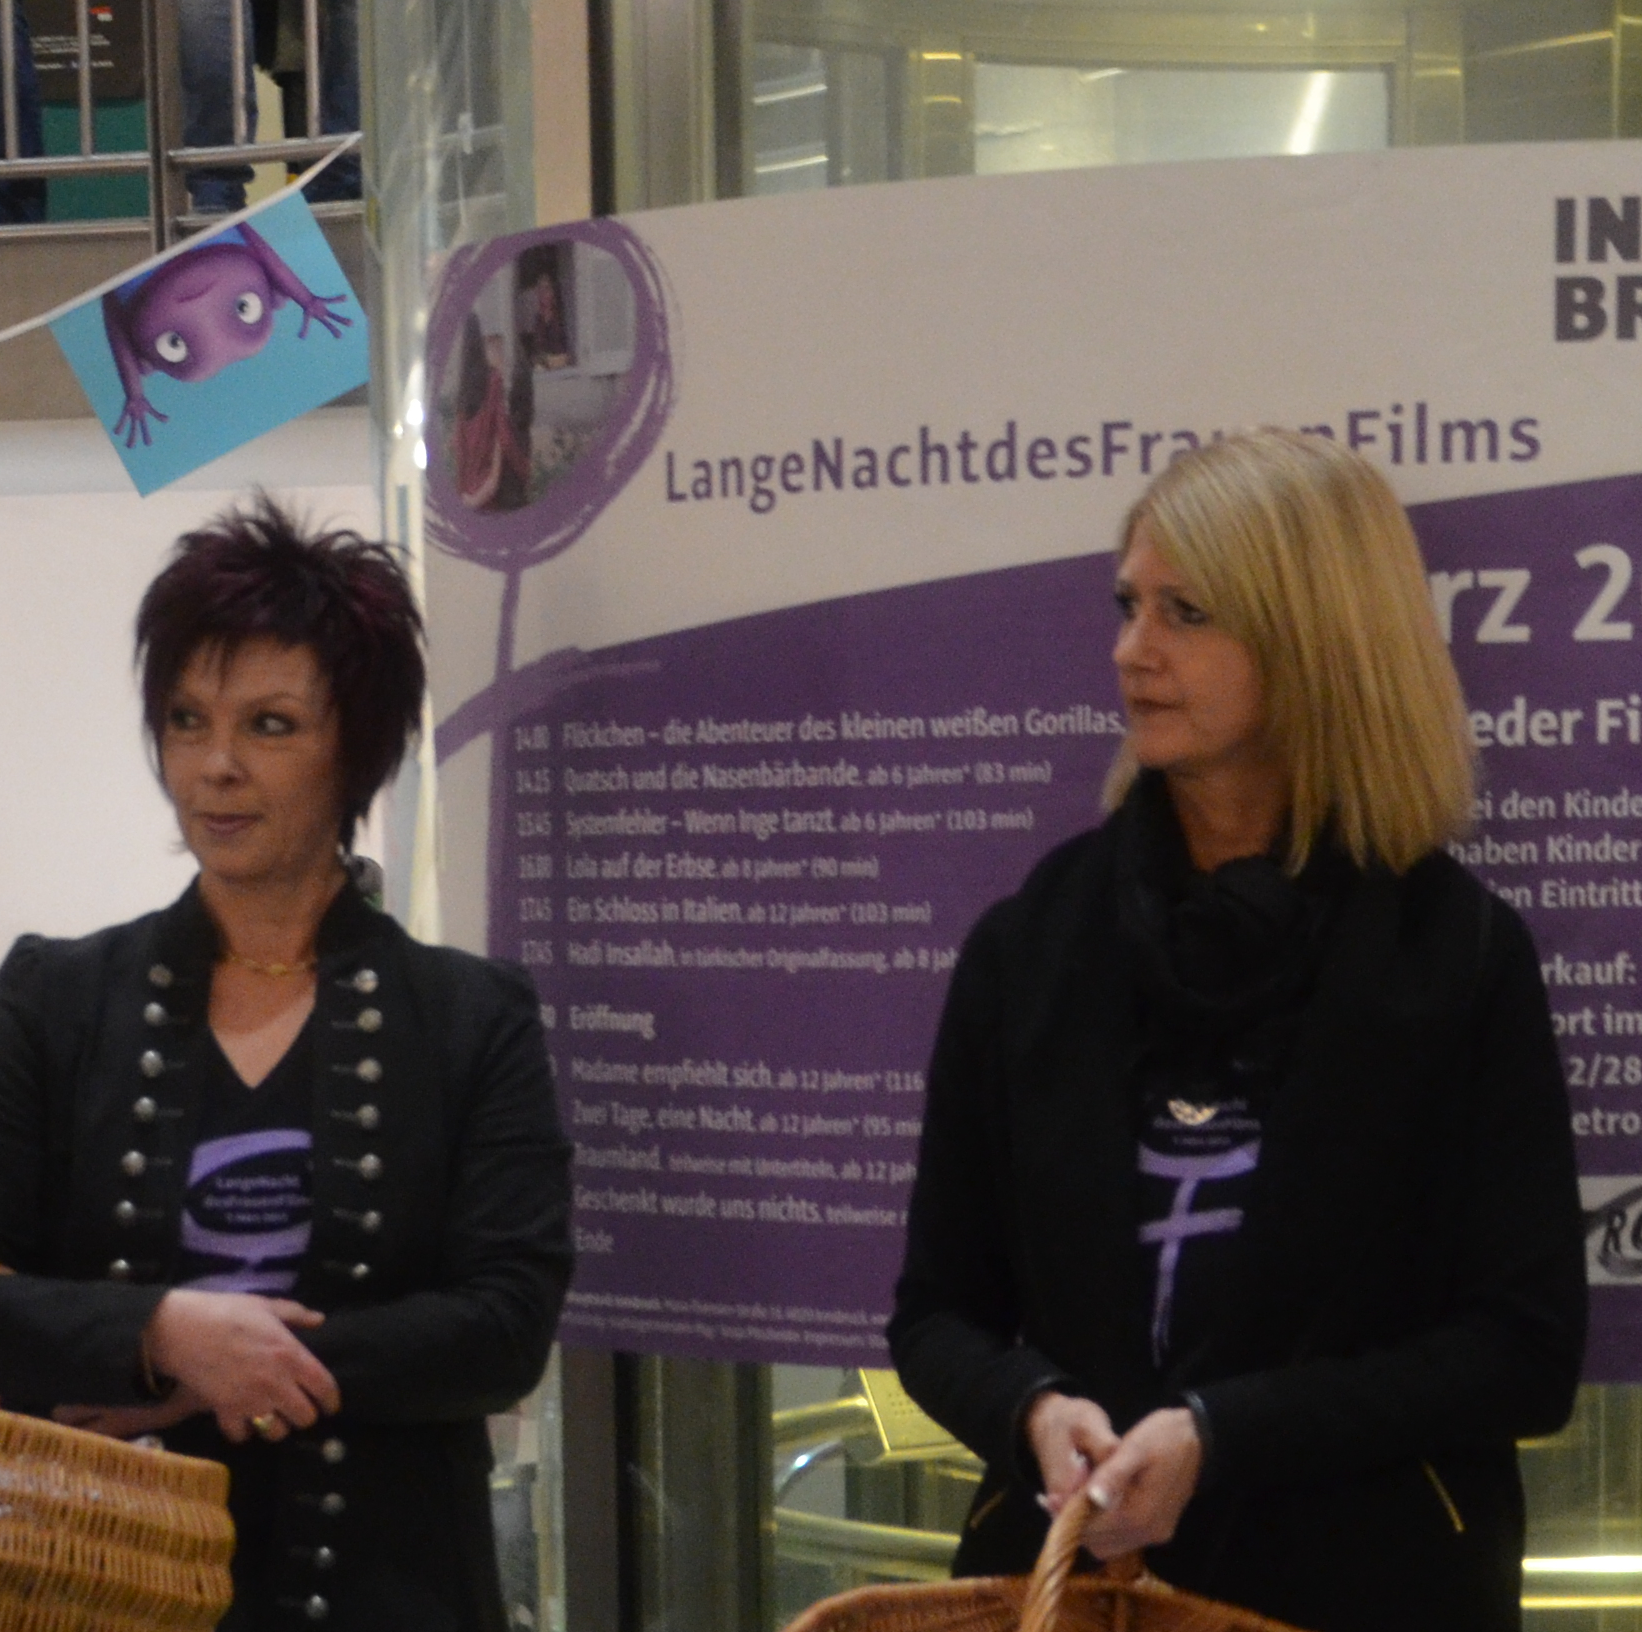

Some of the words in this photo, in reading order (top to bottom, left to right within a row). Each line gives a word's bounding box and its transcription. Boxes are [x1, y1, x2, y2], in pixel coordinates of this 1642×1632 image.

[666, 402, 1542, 513] LangeNachtdesFraFilms
[664, 719, 693, 746] die
[696, 717, 794, 745] Abenteuer
[799, 714, 837, 741] des
[841, 711, 925, 740] kleinen
[930, 707, 1018, 738] weißen
[632, 763, 667, 791] und
[670, 762, 699, 790] die
[1009, 760, 1053, 785] min)
[1500, 787, 1556, 821] den
[684, 810, 736, 835] Wenn
[739, 807, 778, 841] Inge
[991, 807, 1034, 832] min)
[1546, 832, 1642, 864] Kinder
[595, 894, 659, 923] Schloss
[570, 1003, 657, 1041] Eröffnung
[1566, 1053, 1642, 1089] 2/28
[719, 1195, 755, 1220] uns
